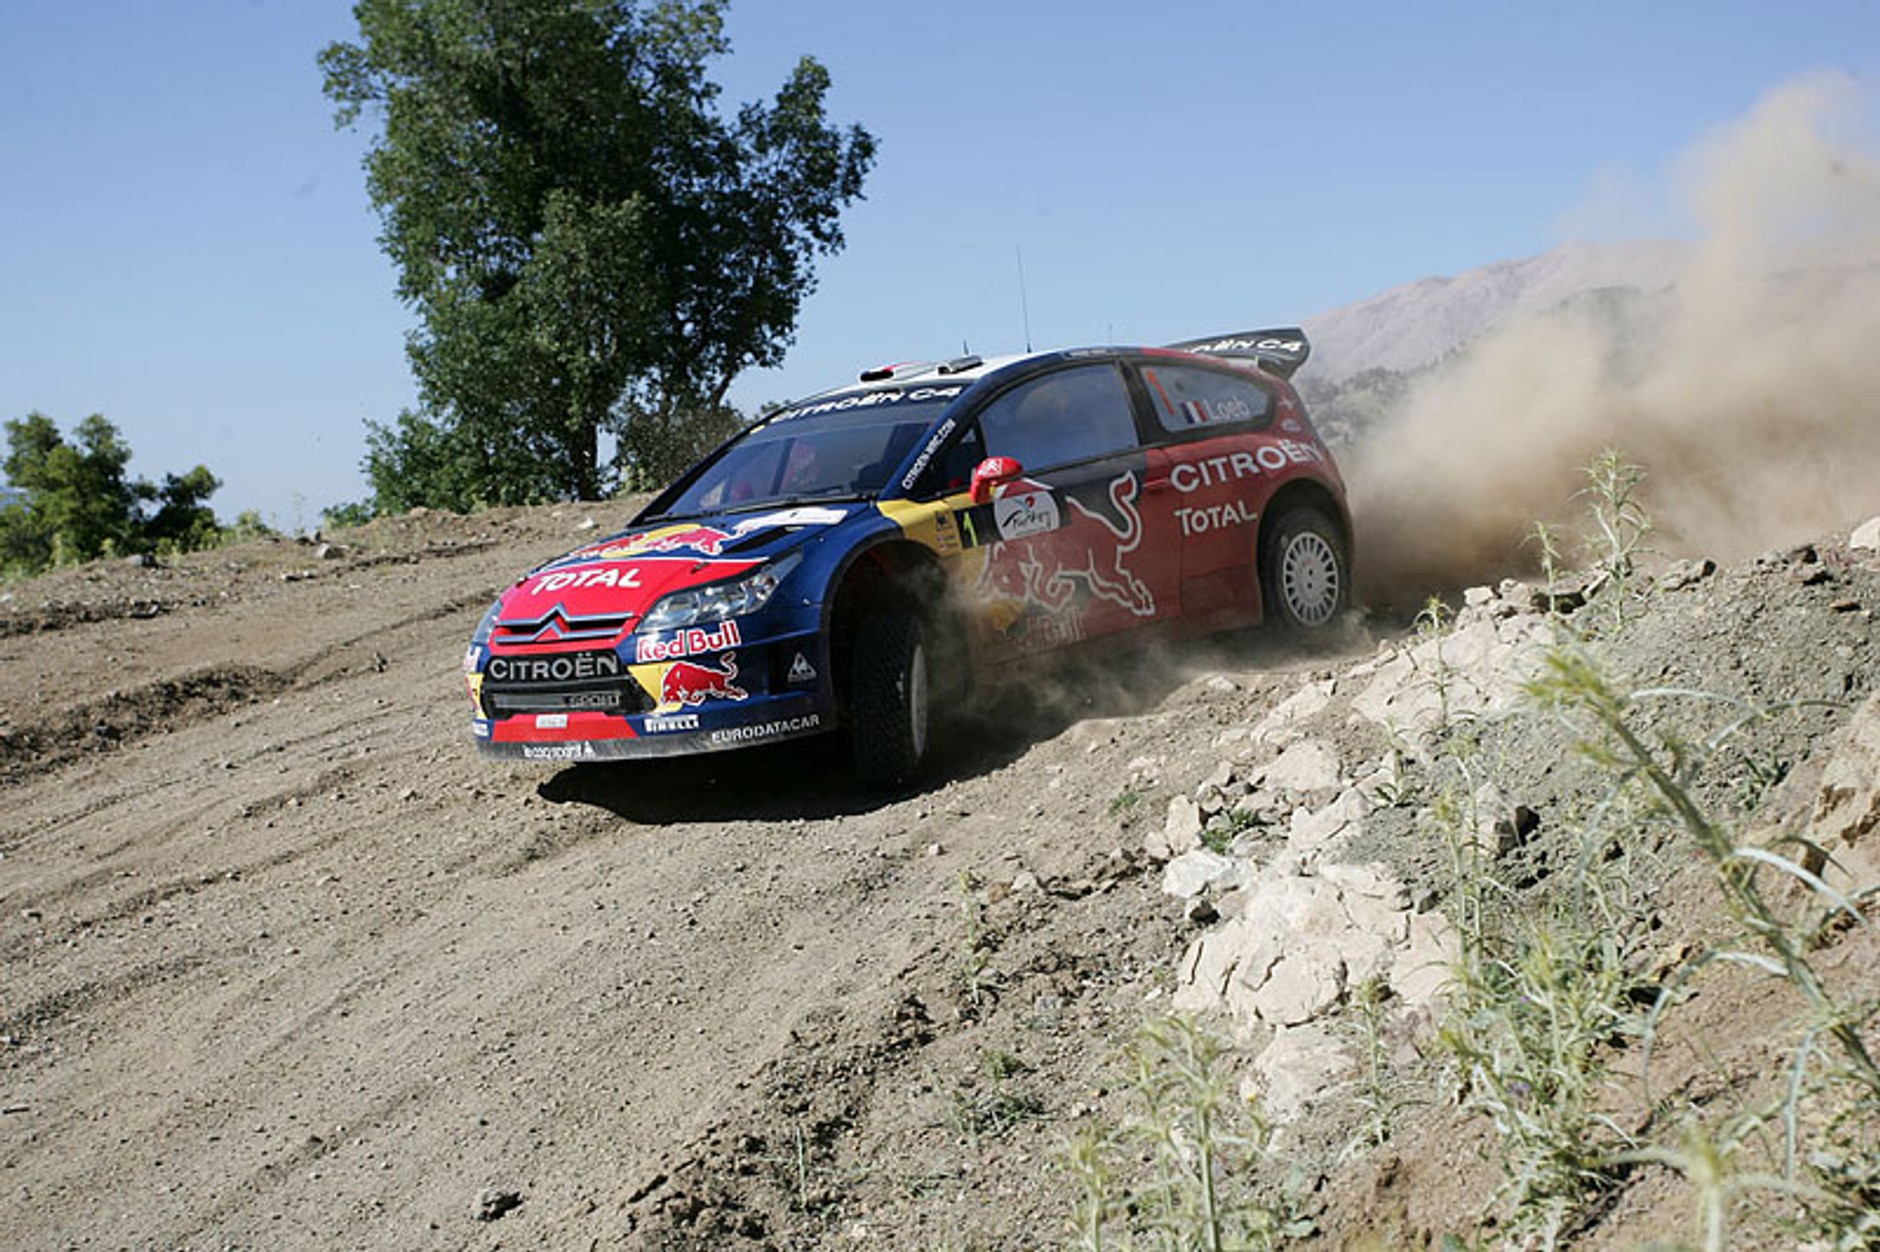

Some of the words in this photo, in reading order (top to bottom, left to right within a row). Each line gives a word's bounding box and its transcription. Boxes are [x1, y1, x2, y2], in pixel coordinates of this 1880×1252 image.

[1203, 396, 1249, 421] Loeb
[1170, 439, 1322, 493] CITROËN
[1174, 500, 1258, 537] TOTAL
[531, 568, 642, 596] TOTAL
[638, 630, 686, 662] Red
[688, 620, 741, 653] Bull
[489, 652, 618, 680] CITROËN
[711, 714, 820, 743] EURODATACAR
